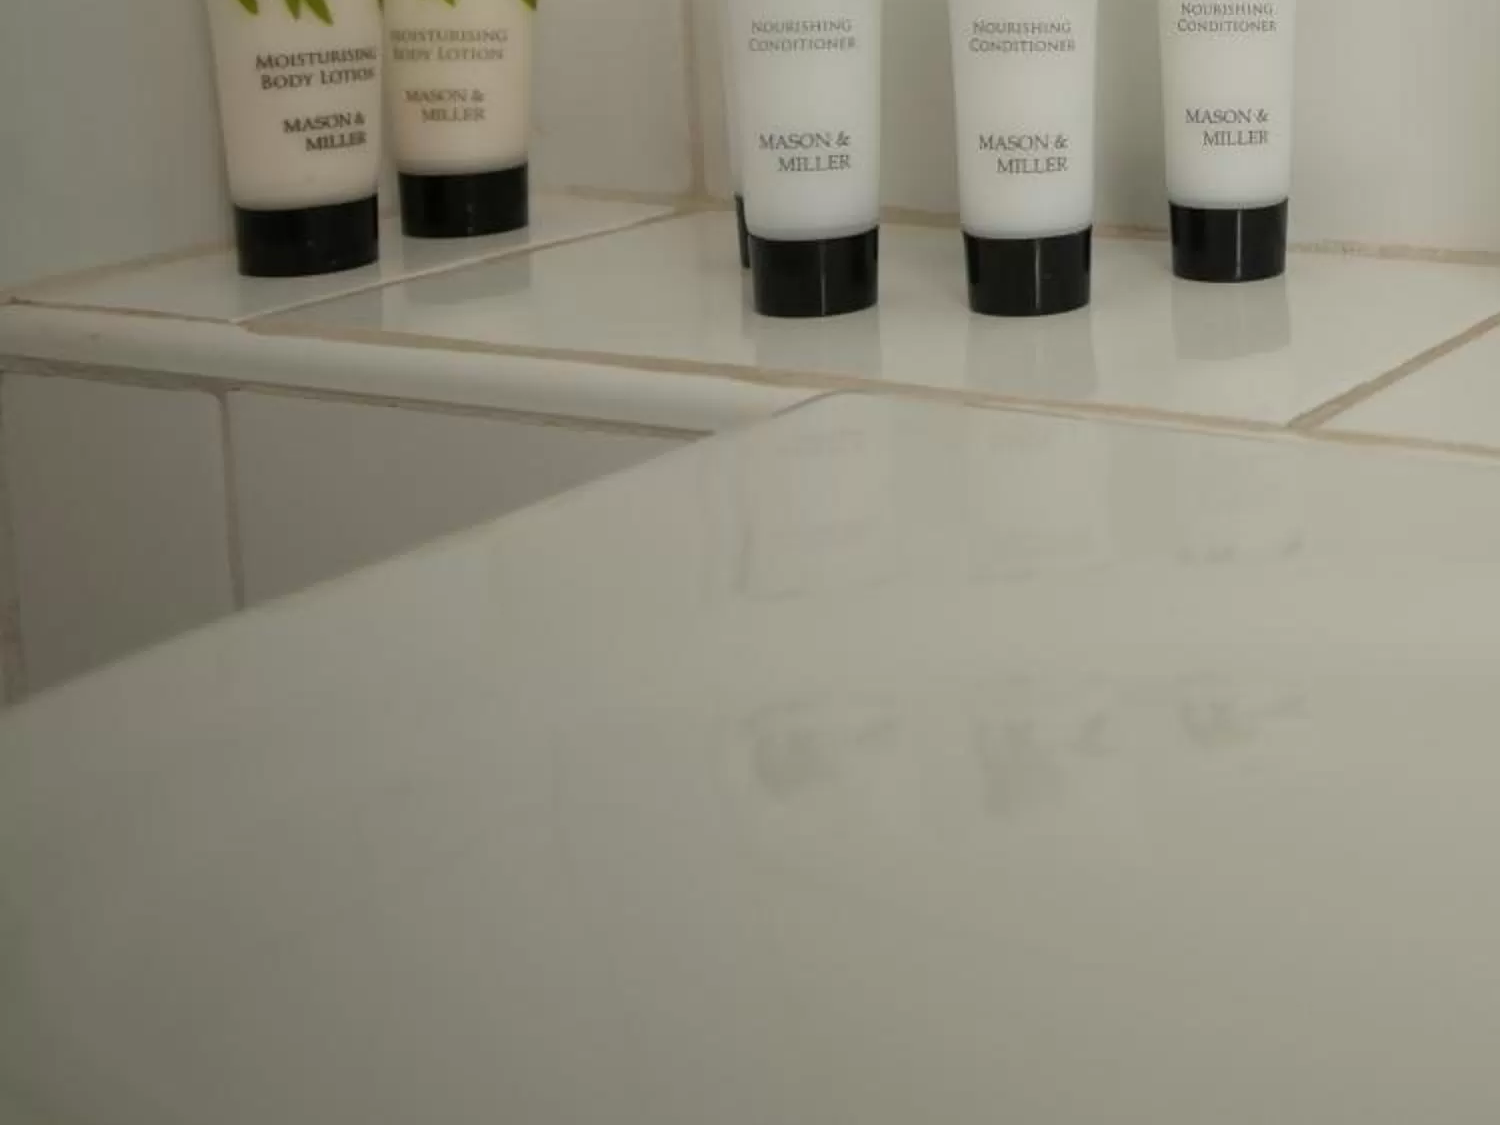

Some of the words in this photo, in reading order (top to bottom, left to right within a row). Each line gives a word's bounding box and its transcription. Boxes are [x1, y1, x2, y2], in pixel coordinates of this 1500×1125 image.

[1180, 2, 1274, 17] NOURISHING
[751, 18, 852, 35] NOURISHING
[972, 18, 1072, 35] NOURISHING
[1176, 17, 1277, 33] CONDITIONER
[438, 46, 504, 60] LOTION
[748, 37, 855, 53] CONDITIONER
[968, 37, 1076, 53] CONDITIONER
[261, 73, 313, 90] BODY
[405, 89, 466, 103] MASON
[470, 89, 485, 102] &
[282, 112, 351, 134] MASON
[421, 107, 486, 122] MILLER
[1185, 108, 1252, 125] MASON
[1255, 108, 1269, 123] &
[305, 131, 367, 151] MILLER
[758, 132, 832, 150] MASON
[834, 131, 850, 147] &
[978, 133, 1052, 151] MASON
[1054, 134, 1068, 150] &
[1202, 128, 1269, 146] MILLER
[777, 154, 851, 172] MILLER
[996, 155, 1068, 174] MILLER
